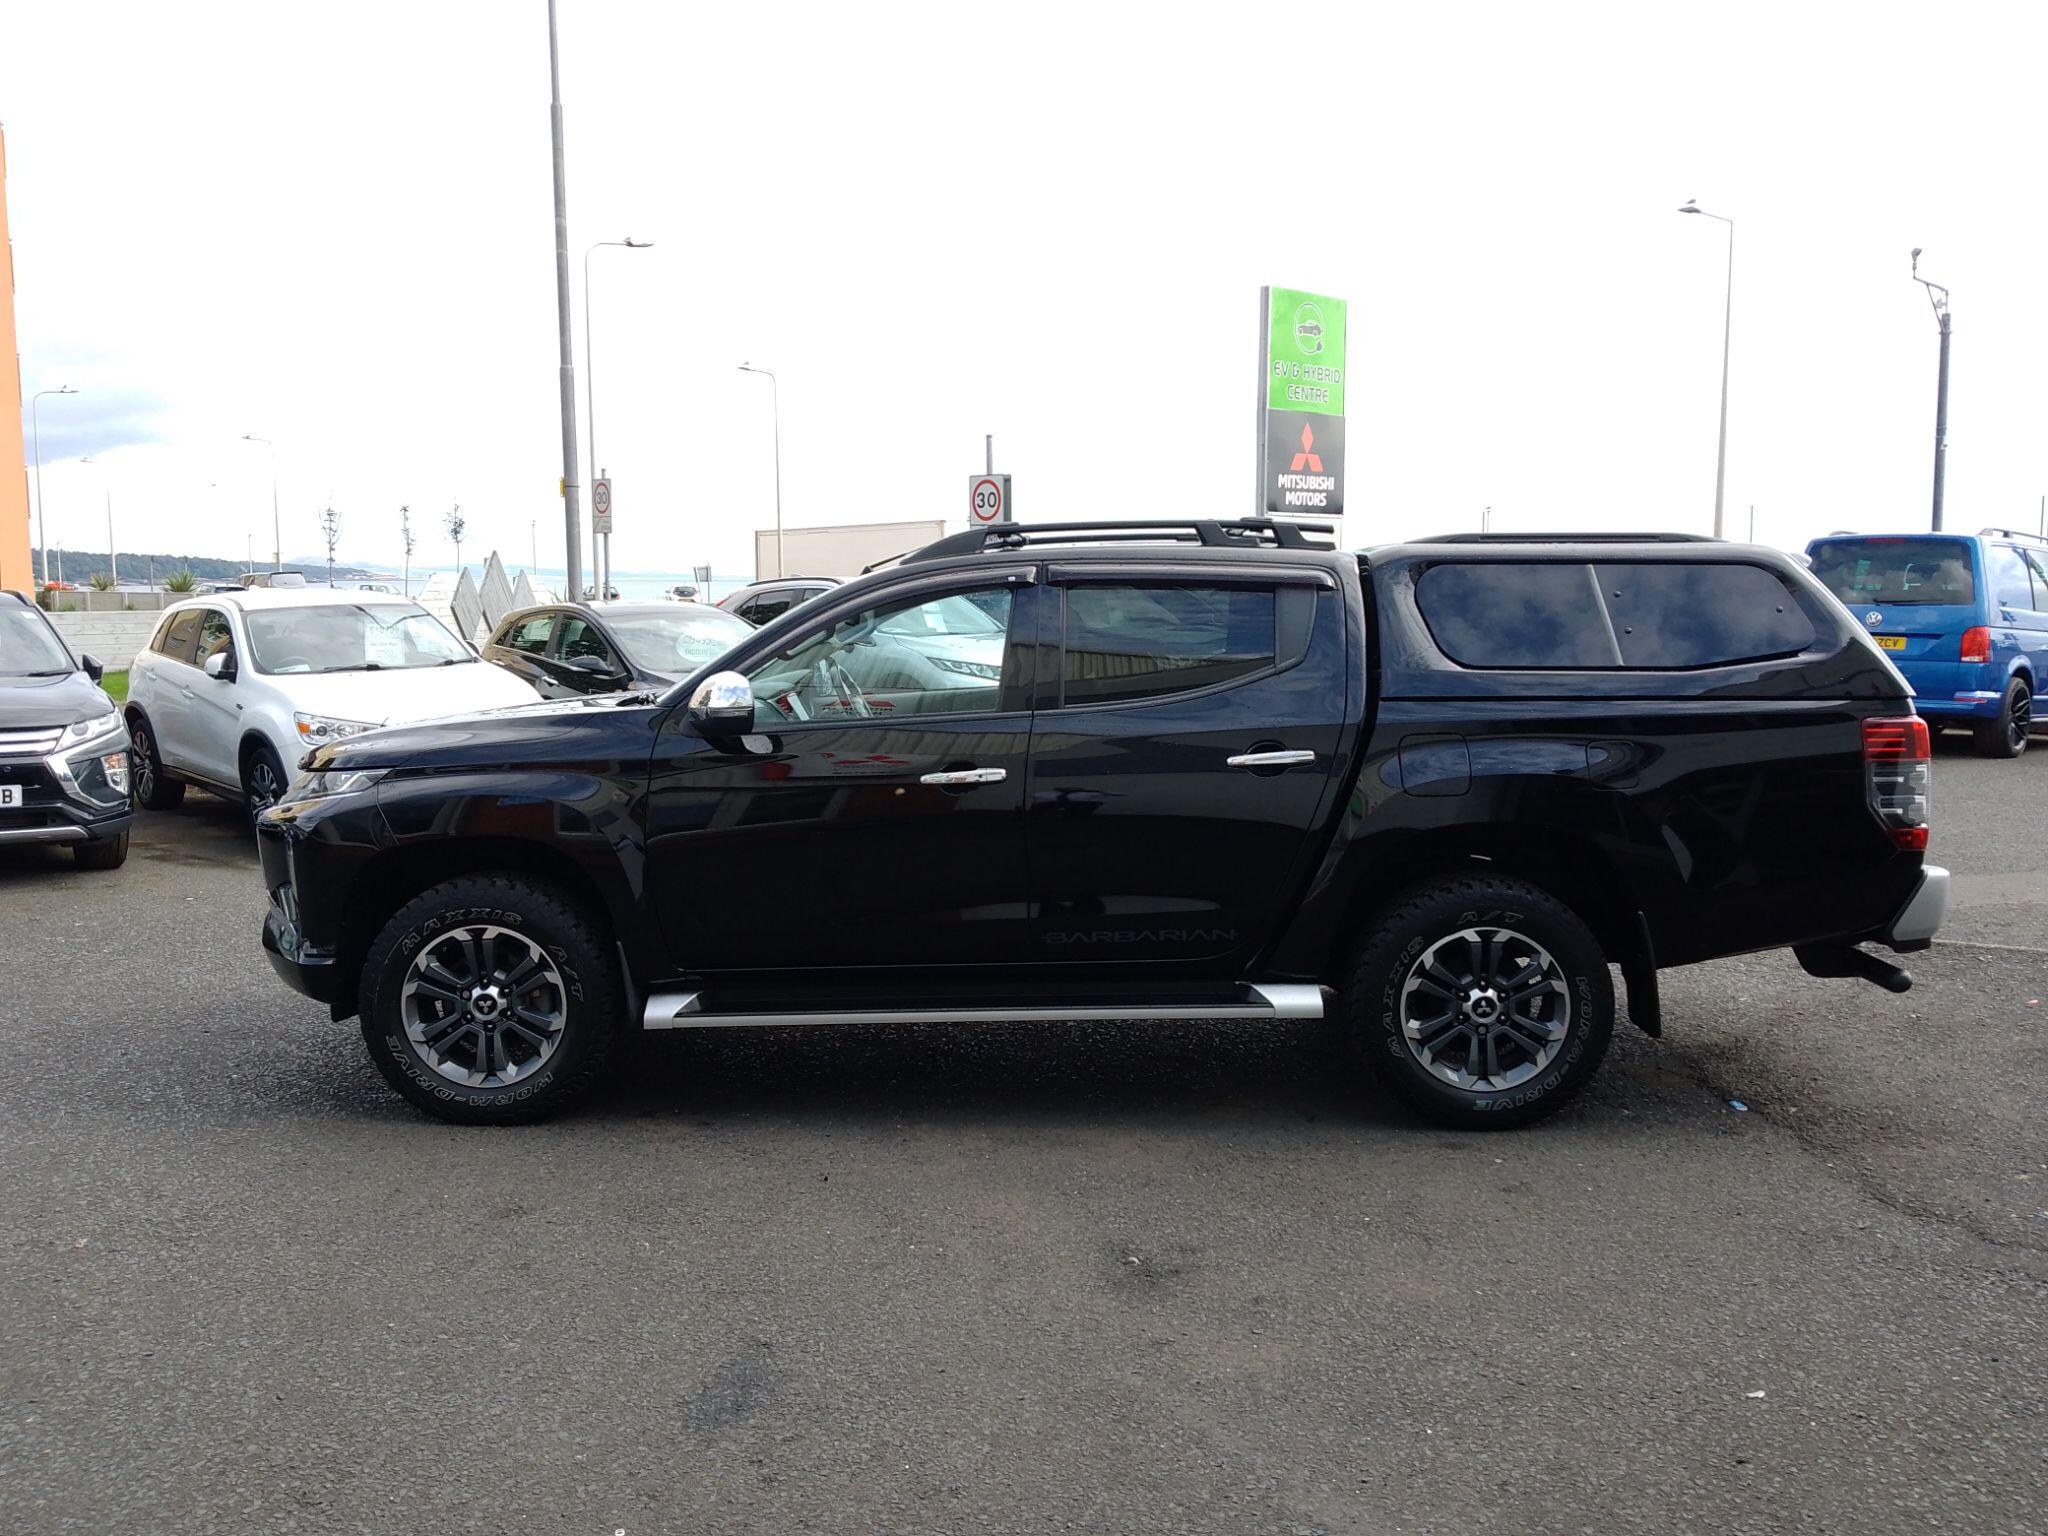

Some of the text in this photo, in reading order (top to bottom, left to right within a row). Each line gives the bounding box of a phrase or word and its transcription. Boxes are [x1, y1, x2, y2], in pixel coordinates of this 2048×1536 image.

[1273, 361, 1341, 384] EV & HYBRID
[1286, 385, 1329, 404] CENTRE
[1278, 474, 1335, 491] MITSUBISHI
[597, 491, 607, 504] 30
[976, 491, 997, 509] 30
[1285, 491, 1327, 507] MOTORS
[2, 789, 13, 804] B
[1456, 910, 1526, 926] A/T
[400, 907, 523, 956] MAXXIS
[1043, 928, 1238, 944] BARBARIAN
[1382, 936, 1425, 1059] MAXXIS
